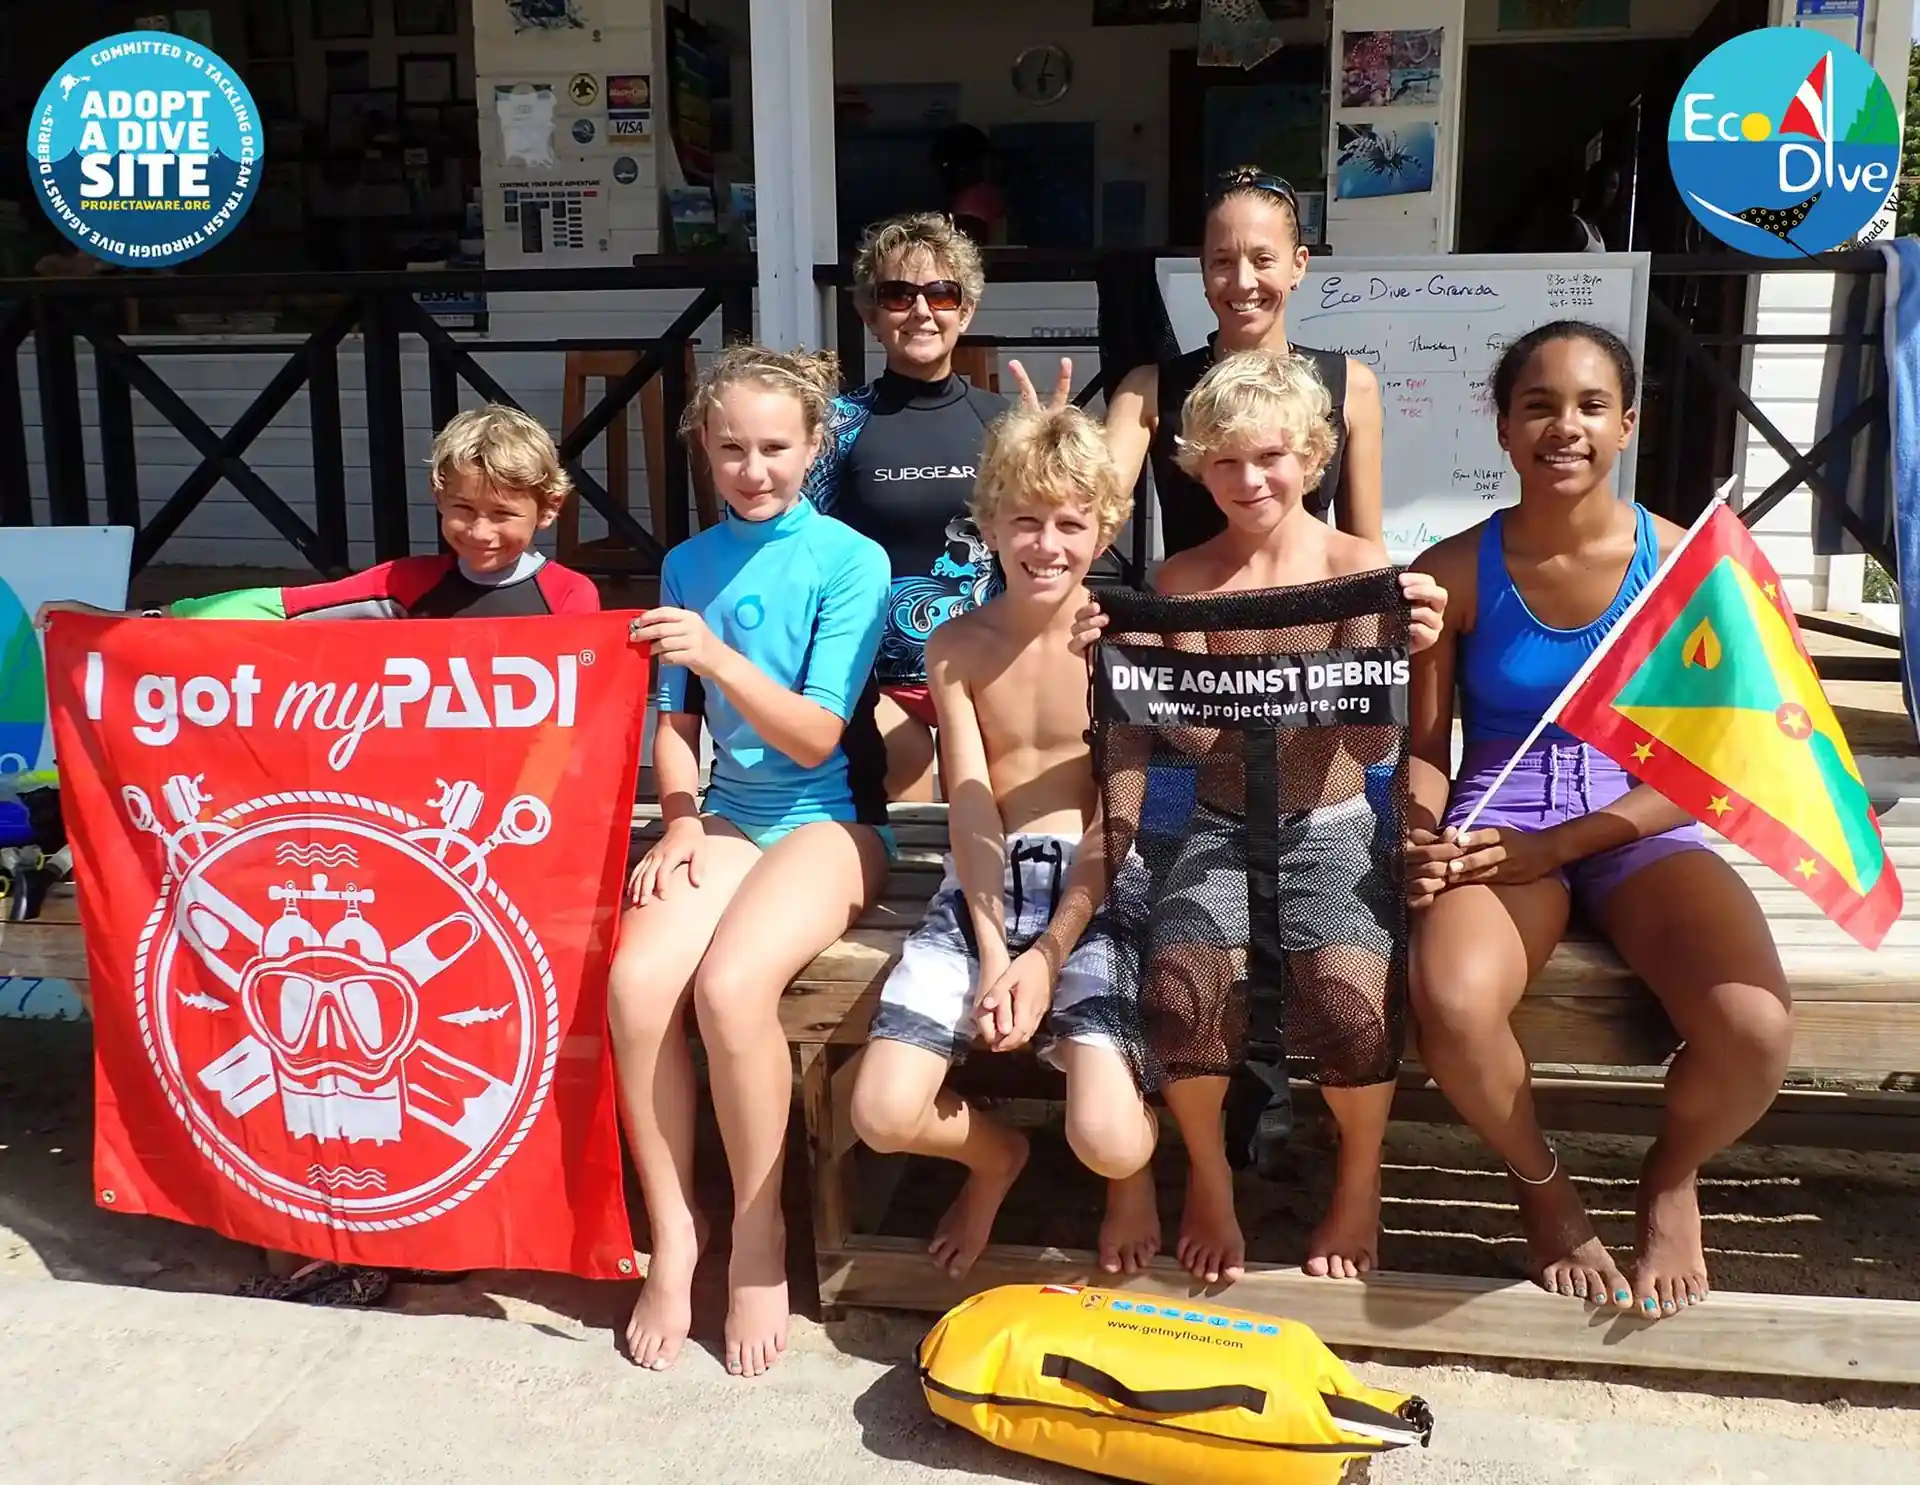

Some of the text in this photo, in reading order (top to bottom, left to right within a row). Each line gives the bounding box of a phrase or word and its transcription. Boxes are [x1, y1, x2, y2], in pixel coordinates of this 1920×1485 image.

[616, 121, 643, 134] VISA
[1321, 277, 1361, 309] Eco
[1369, 278, 1410, 301] Dive
[873, 465, 977, 482] SUBGEAR
[1473, 468, 1507, 480] NIGHT
[1112, 660, 1410, 694] DIVE AGAINST DEBRIS
[84, 651, 104, 720] I
[132, 664, 261, 746] got
[1148, 695, 1371, 719] www.projectaware.org
[1107, 1319, 1244, 1349] www.getmyfloat.com
